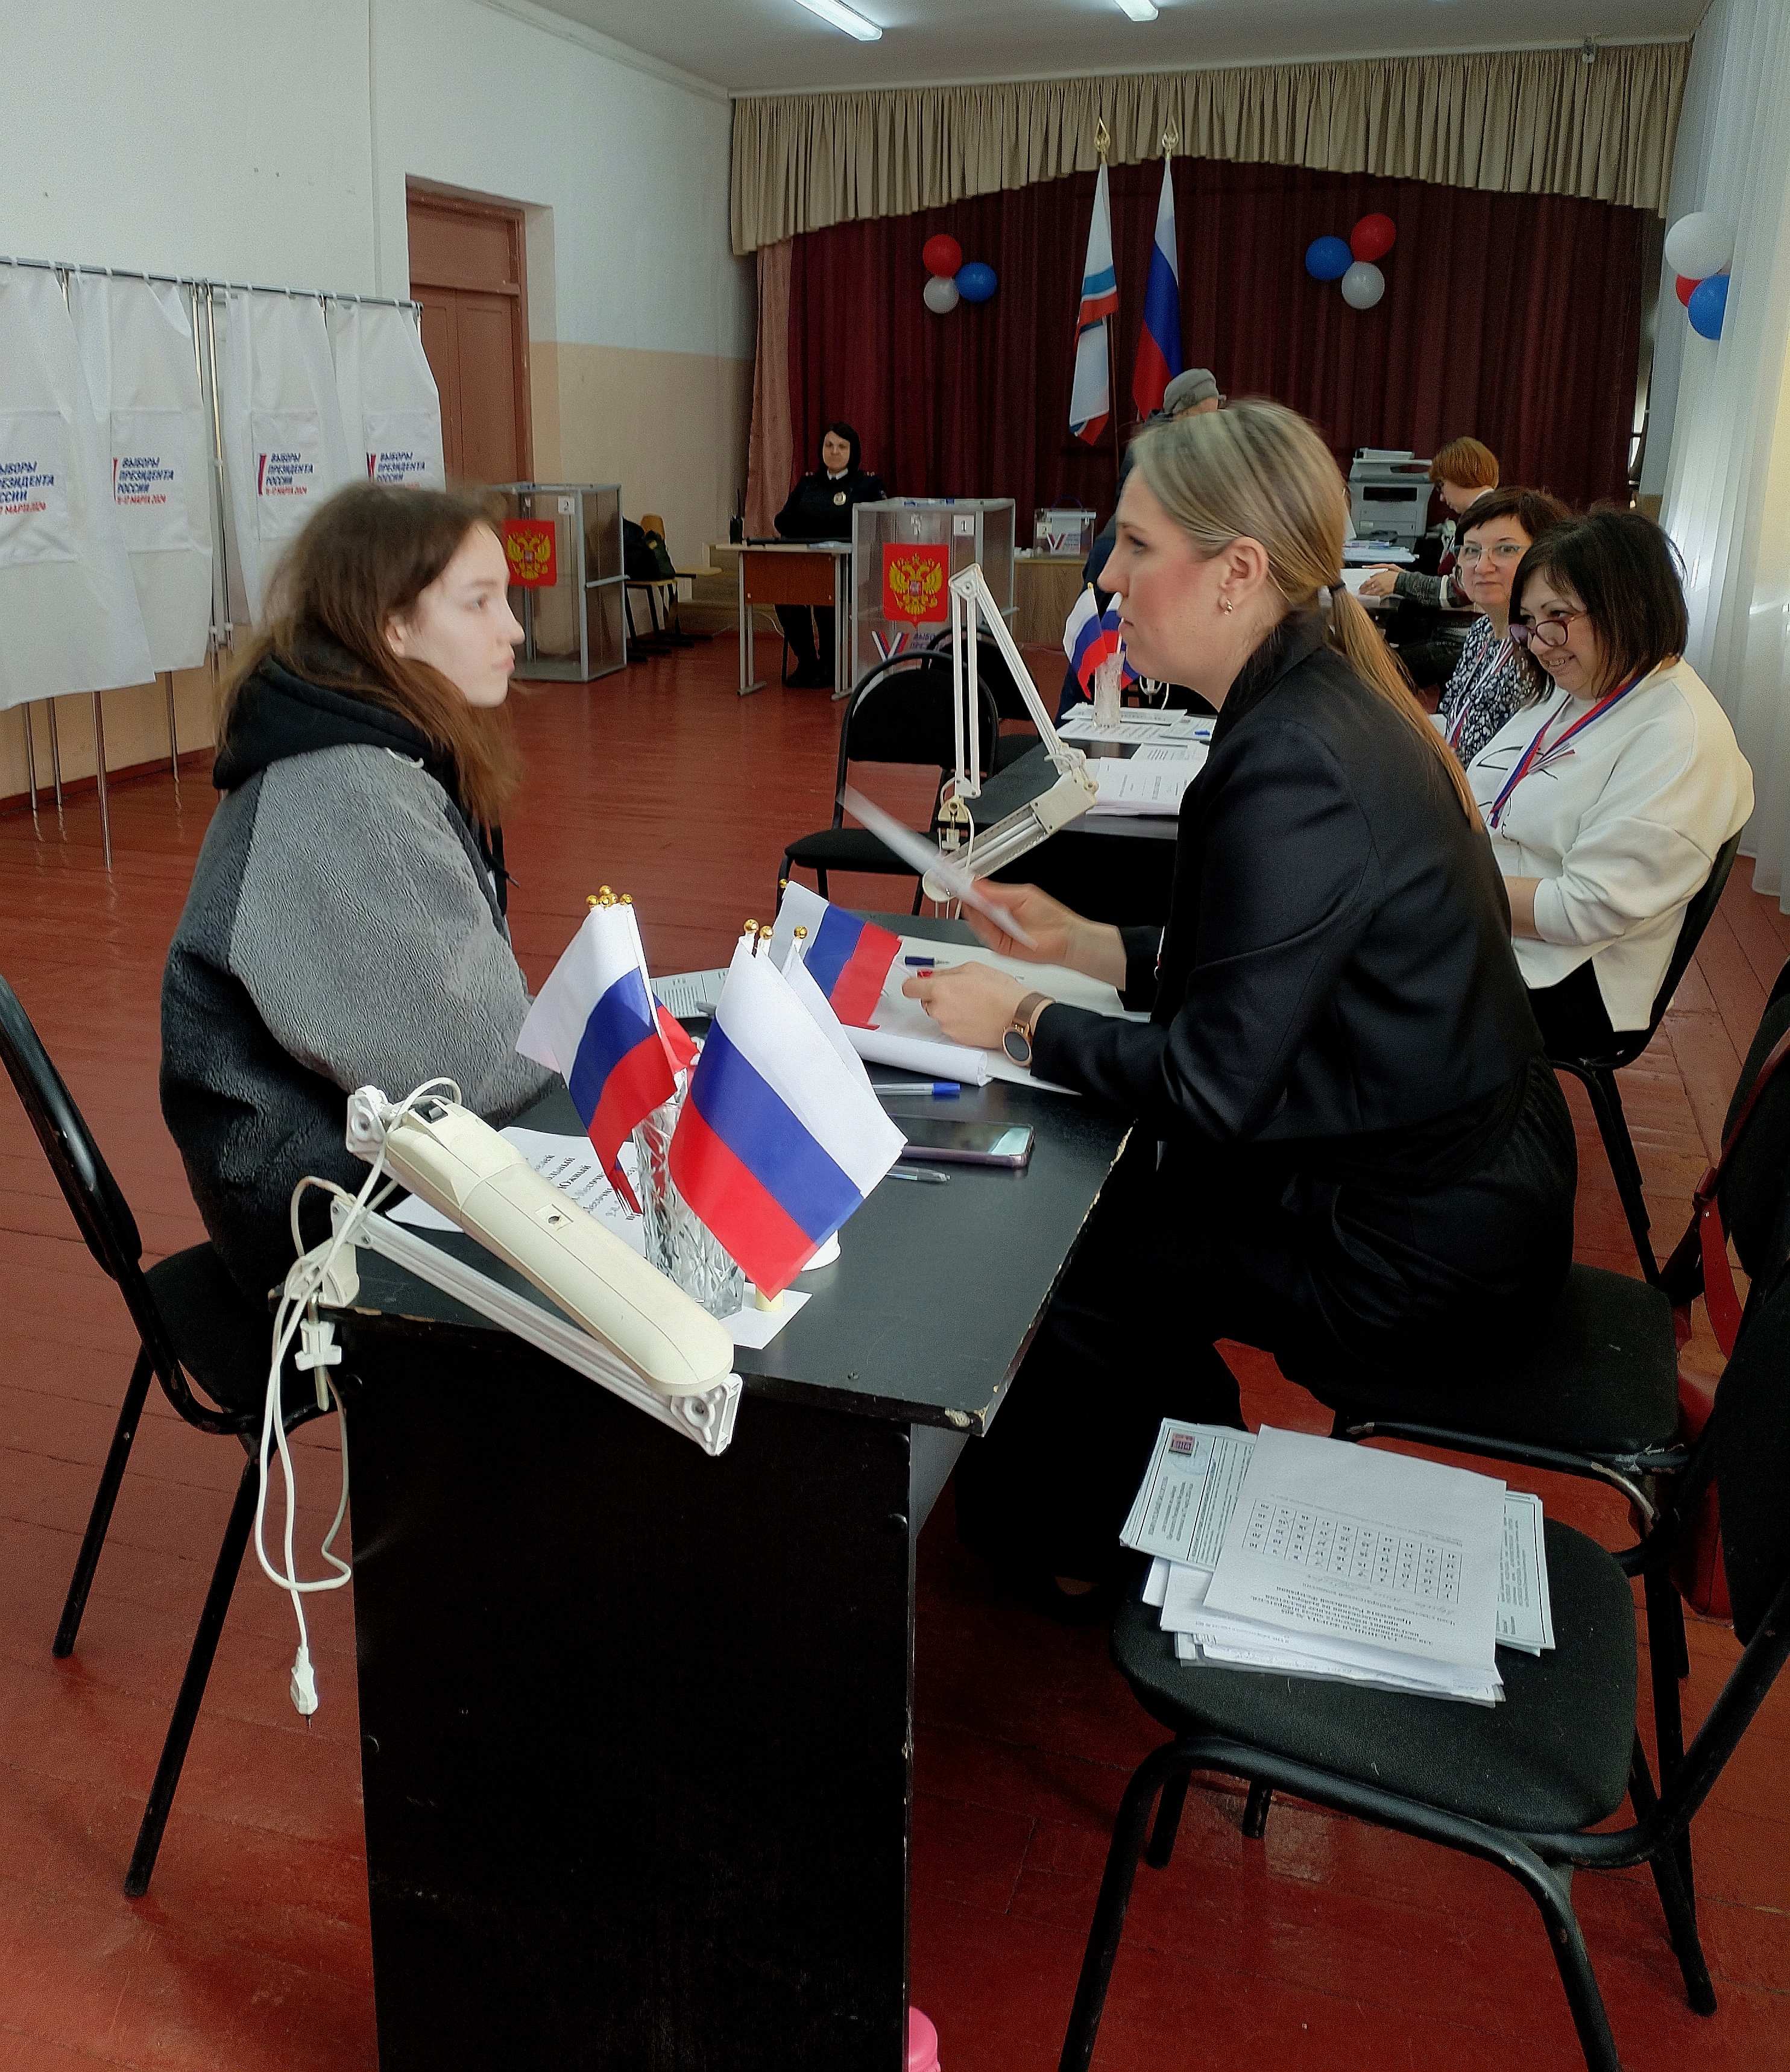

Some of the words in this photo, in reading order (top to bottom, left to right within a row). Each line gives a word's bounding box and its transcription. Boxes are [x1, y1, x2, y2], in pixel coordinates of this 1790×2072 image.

[122, 456, 160, 468] ВЫБОРЫ
[378, 461, 425, 472] ПРЕЗИДЕНТА
[268, 463, 314, 474] ПРЕЗИДЕНТА
[119, 469, 174, 482] ПРЕЗИДЕНТА
[117, 482, 150, 494] РОССИИ
[960, 519, 968, 533] 1
[557, 1164, 592, 1189] Южный
